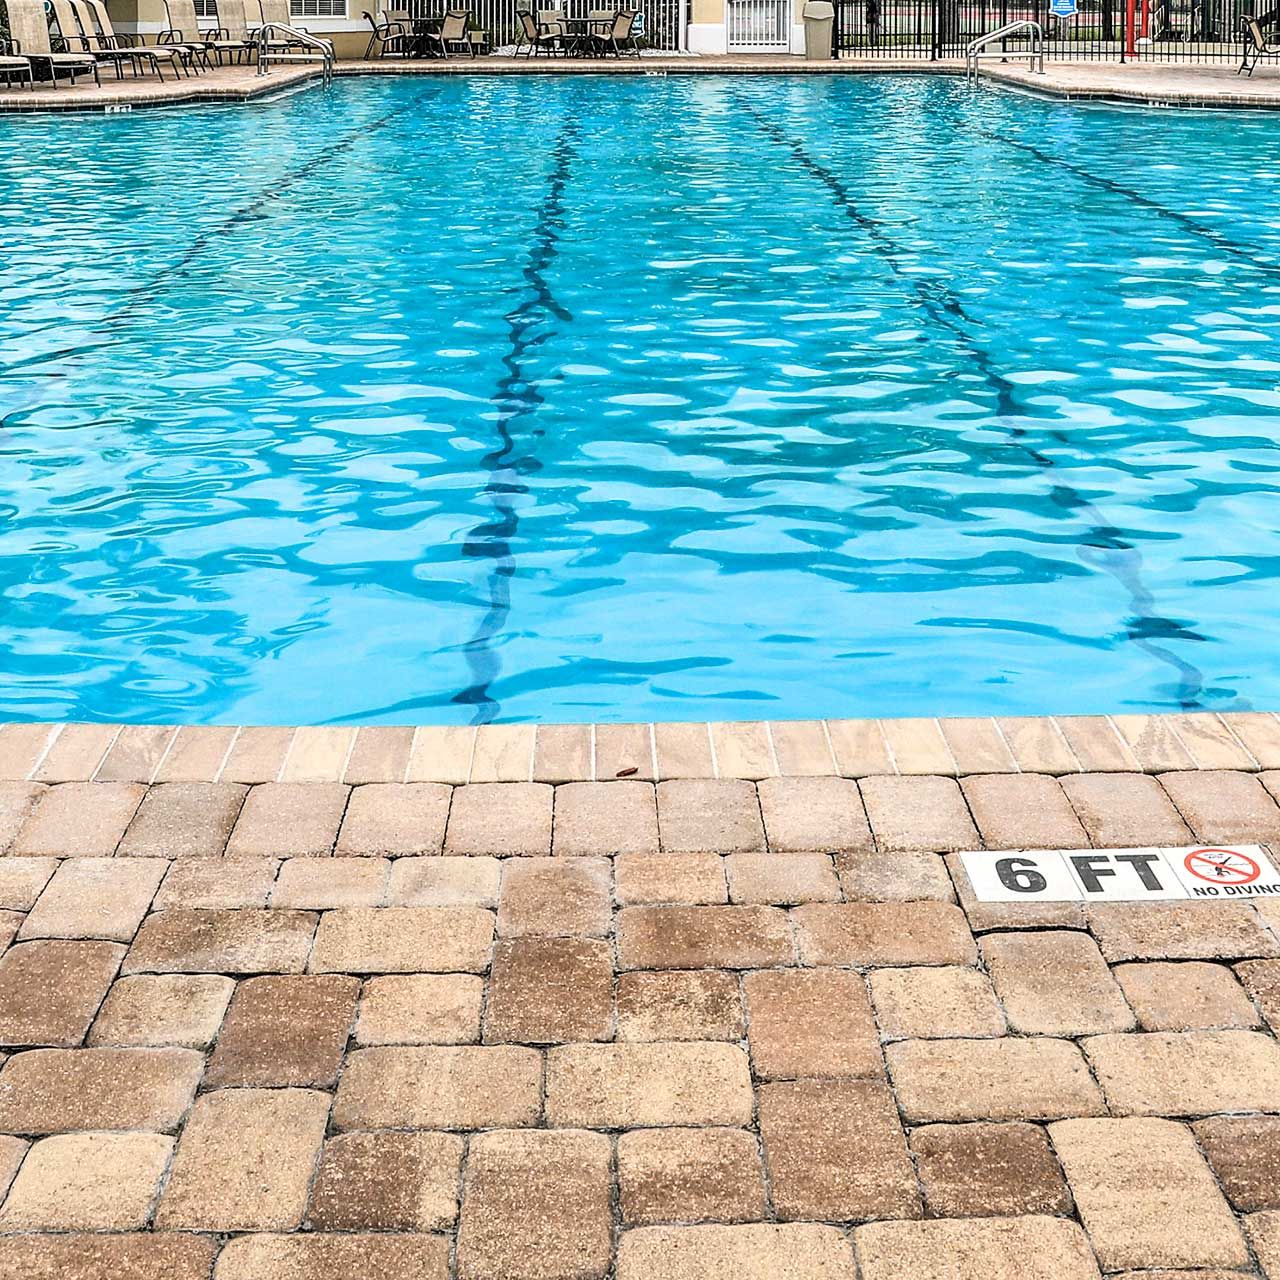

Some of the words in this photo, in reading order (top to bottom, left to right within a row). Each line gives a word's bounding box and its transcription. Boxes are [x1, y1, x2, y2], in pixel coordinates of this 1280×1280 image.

[994, 856, 1048, 894] 6
[1069, 853, 1165, 893] FT
[1192, 886, 1220, 897] NO
